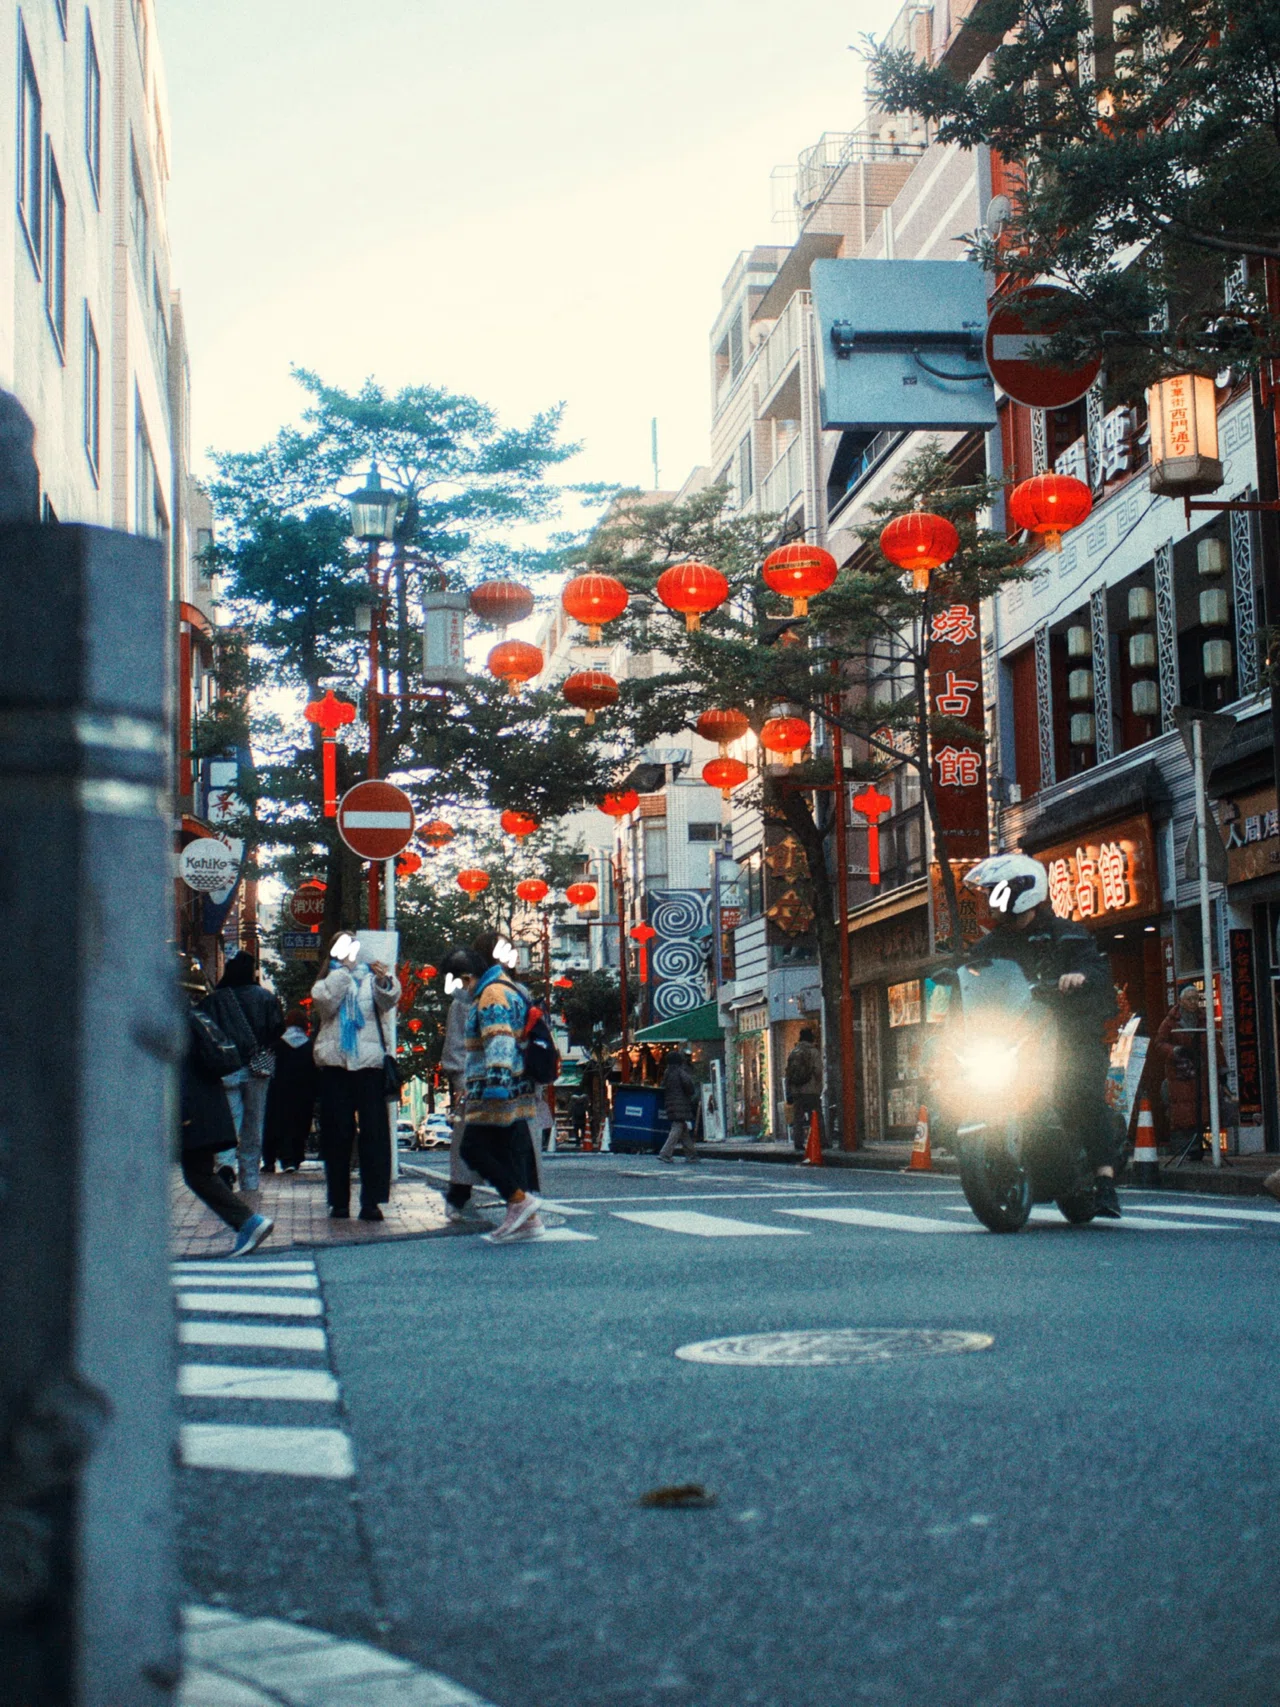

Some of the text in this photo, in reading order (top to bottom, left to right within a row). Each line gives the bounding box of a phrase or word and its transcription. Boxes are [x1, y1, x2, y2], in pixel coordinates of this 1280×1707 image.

[1169, 379, 1190, 455] 中華街西門通り
[930, 604, 981, 786] 縁占館
[1048, 842, 1126, 919] 縁占館
